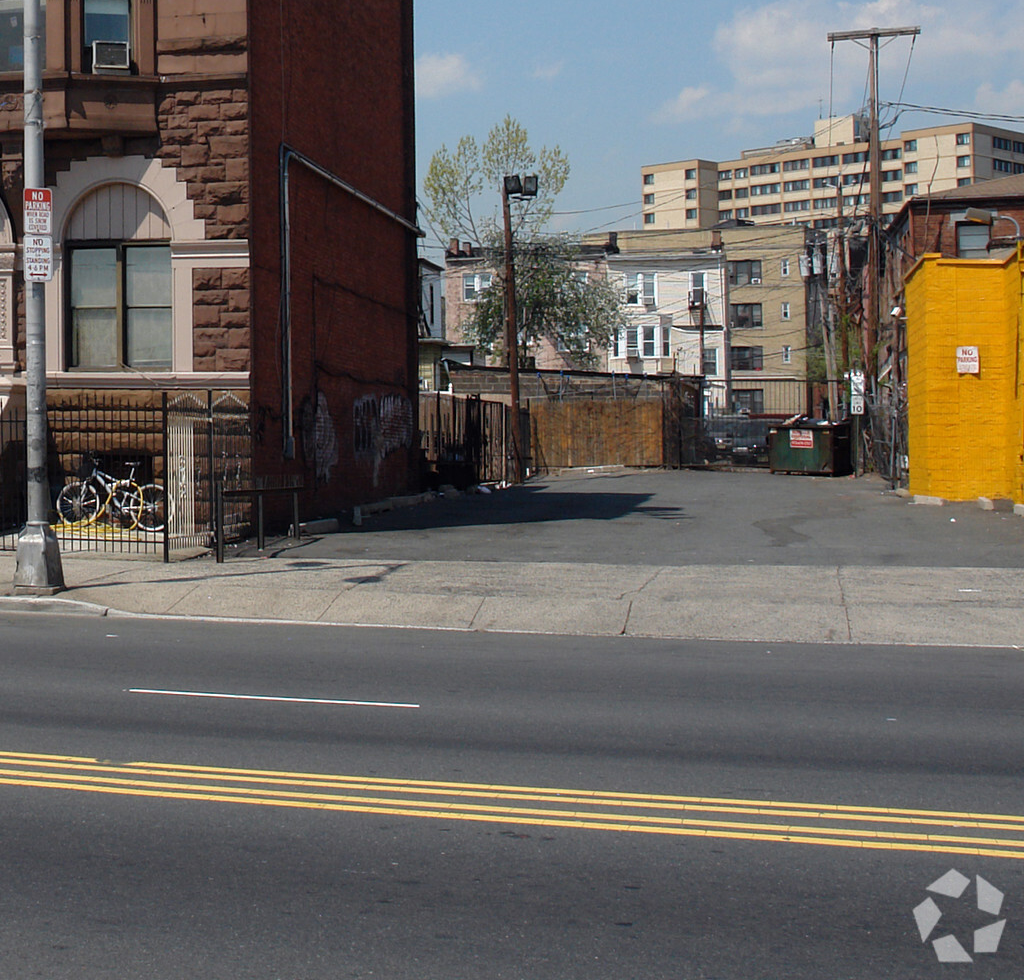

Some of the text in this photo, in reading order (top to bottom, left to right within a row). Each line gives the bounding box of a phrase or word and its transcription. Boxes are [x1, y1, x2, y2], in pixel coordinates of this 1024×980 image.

[32, 191, 44, 200] NO
[25, 201, 50, 210] PARKING
[852, 405, 863, 413] 10
